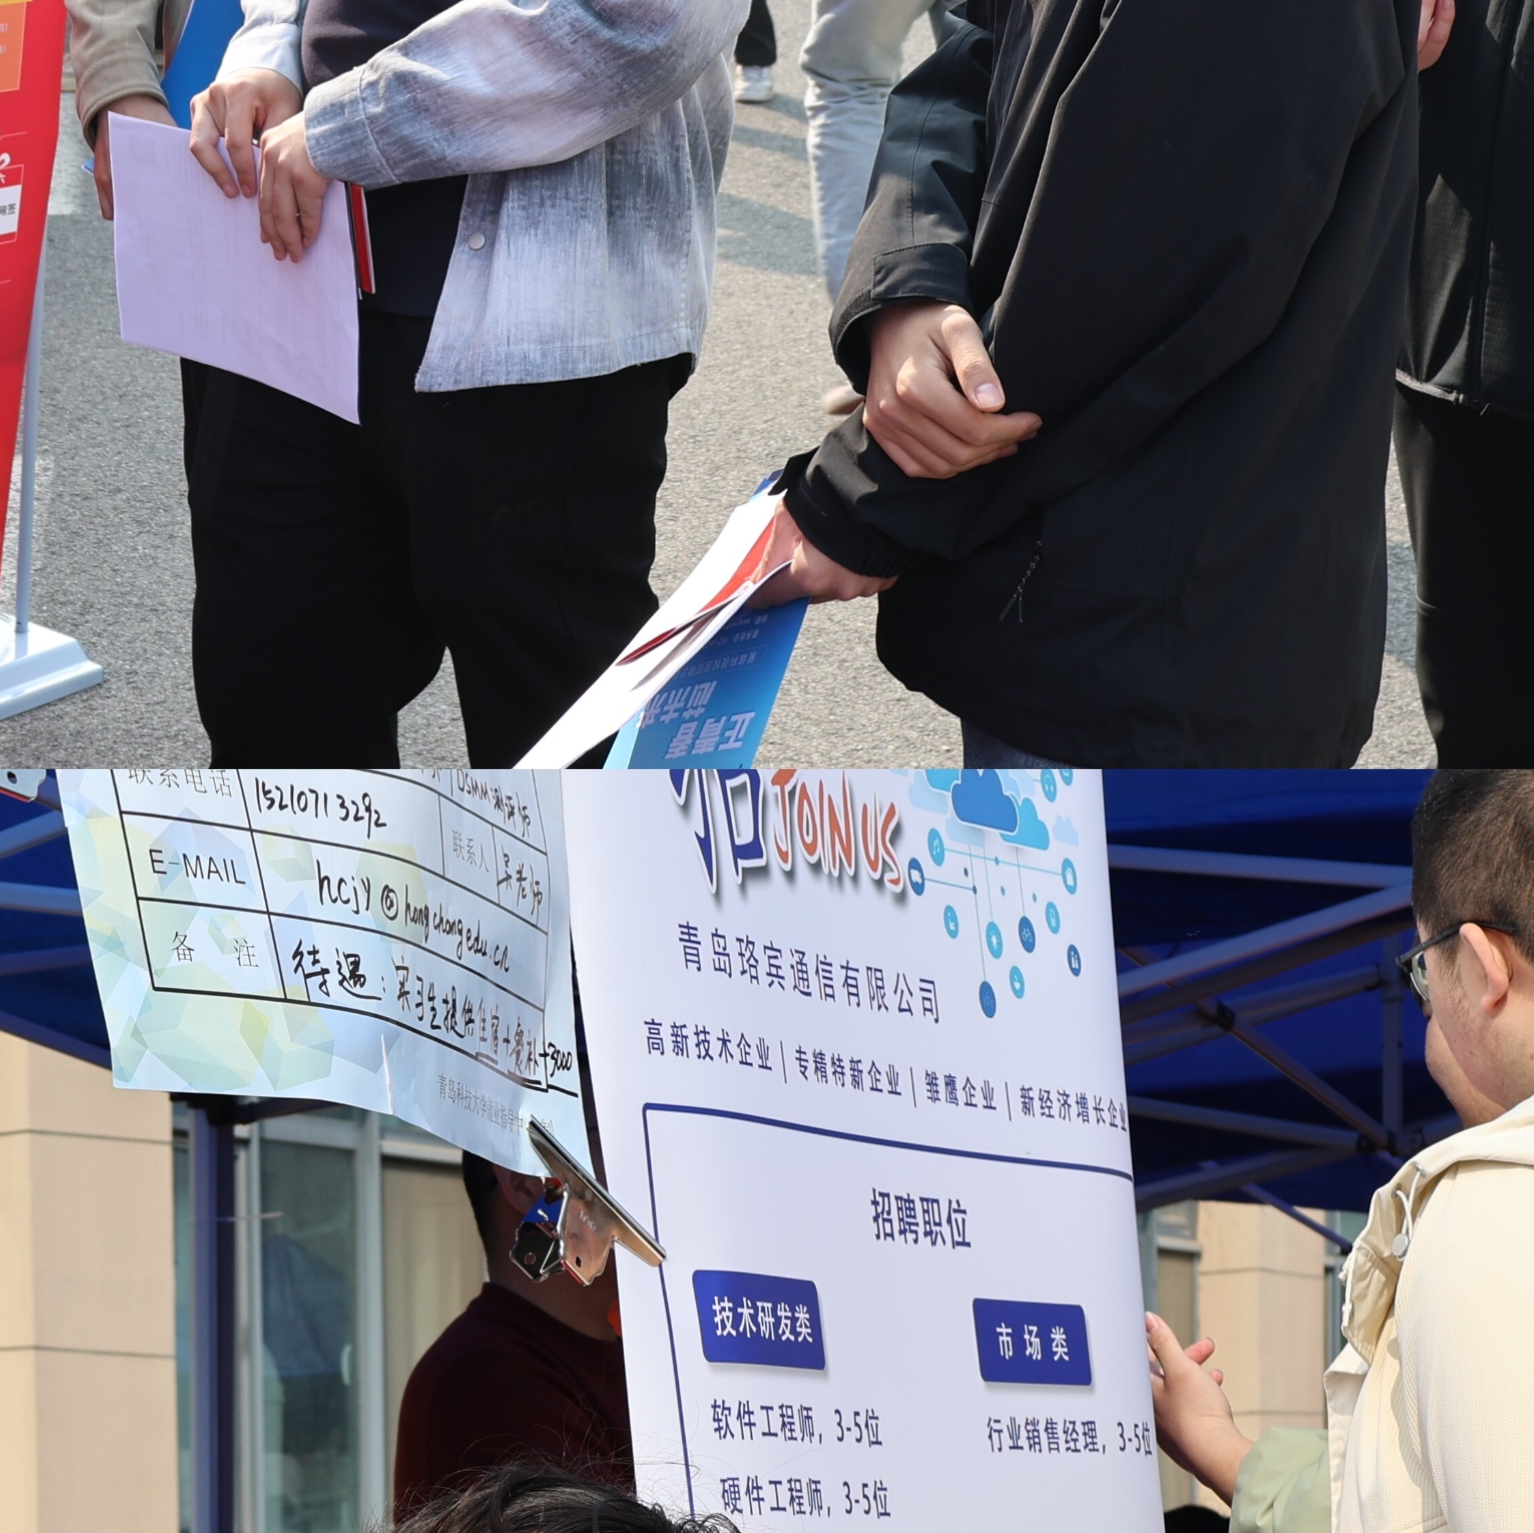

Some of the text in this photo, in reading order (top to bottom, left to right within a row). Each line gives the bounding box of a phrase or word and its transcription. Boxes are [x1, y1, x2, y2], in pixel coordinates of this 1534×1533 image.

[664, 708, 757, 760] 正青春
[149, 848, 247, 885] E-MAIL
[451, 829, 490, 874] 联系人
[860, 792, 907, 894] US
[677, 920, 941, 1025] 青岛珞宾通信有限公司
[644, 1017, 773, 1072] 高新技术企业
[794, 1043, 903, 1099] 专精特新企业
[870, 1187, 972, 1251] 招聘职位
[711, 1295, 814, 1344] 技术研发类
[996, 1321, 1071, 1363] 市场类
